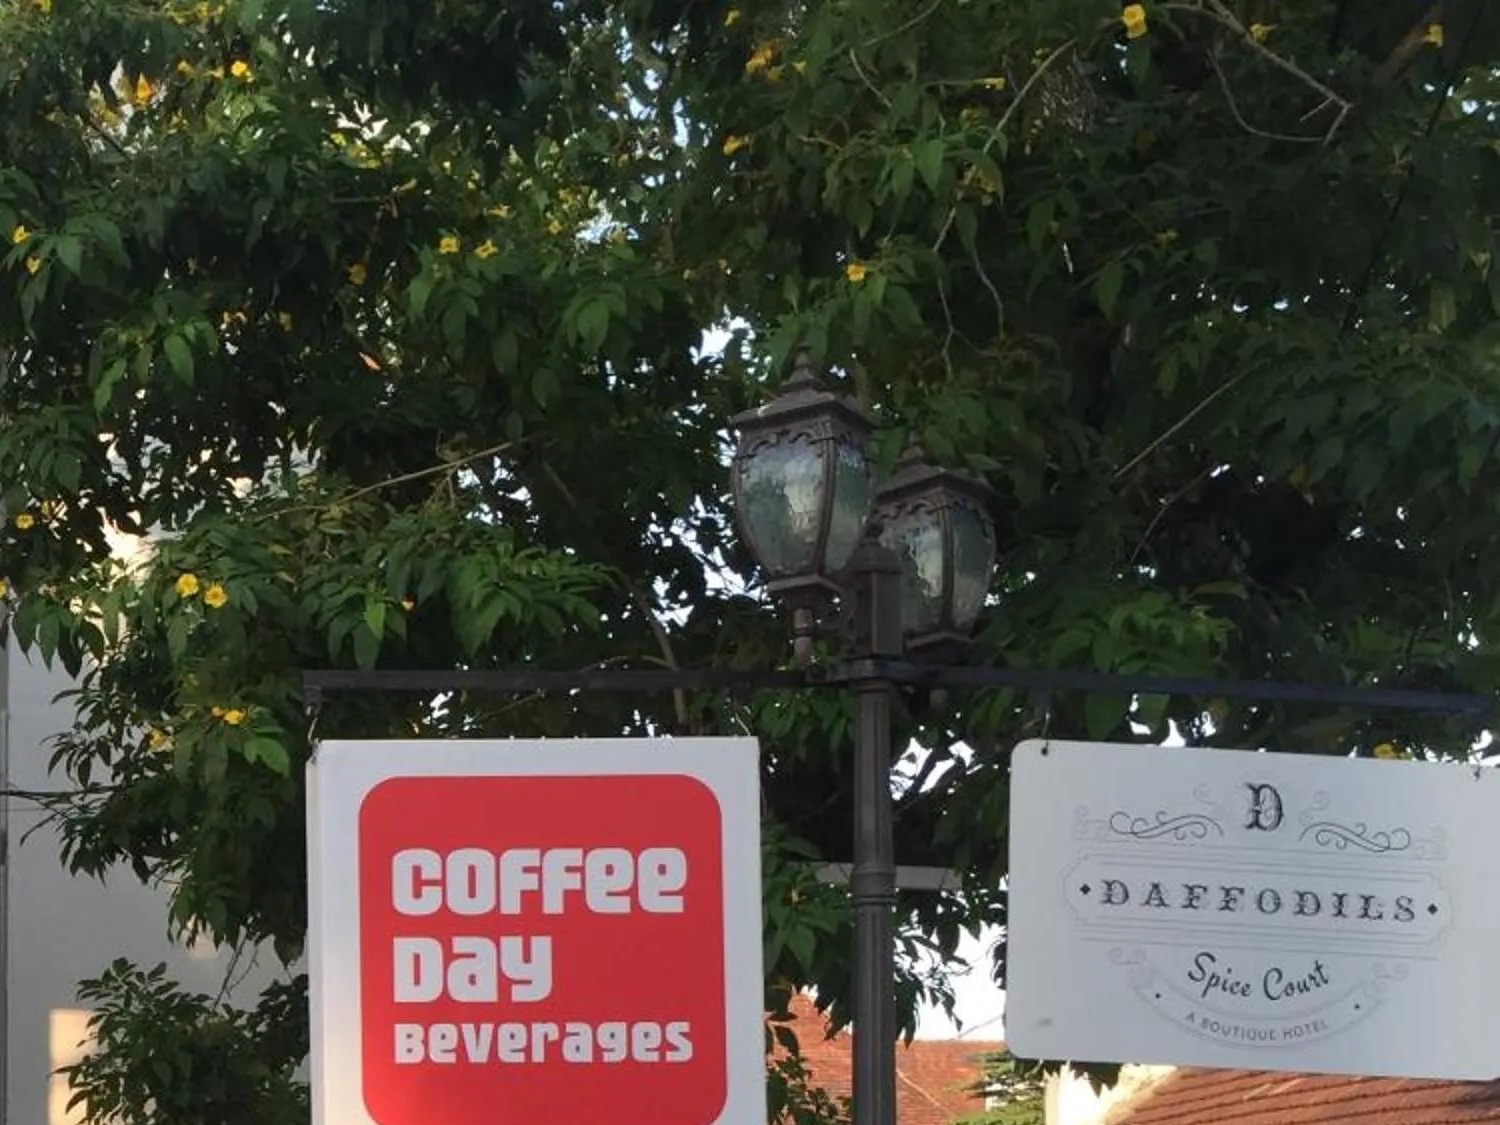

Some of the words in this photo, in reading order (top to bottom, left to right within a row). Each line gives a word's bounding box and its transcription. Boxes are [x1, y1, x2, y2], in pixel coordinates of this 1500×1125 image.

[1244, 782, 1284, 832] D
[1100, 878, 1416, 922] DAFFODILS
[1187, 951, 1251, 999] Spice
[1263, 959, 1329, 1001] Court
[1201, 1016, 1276, 1041] BOUTIQUE
[1283, 1018, 1330, 1041] HOTEL
